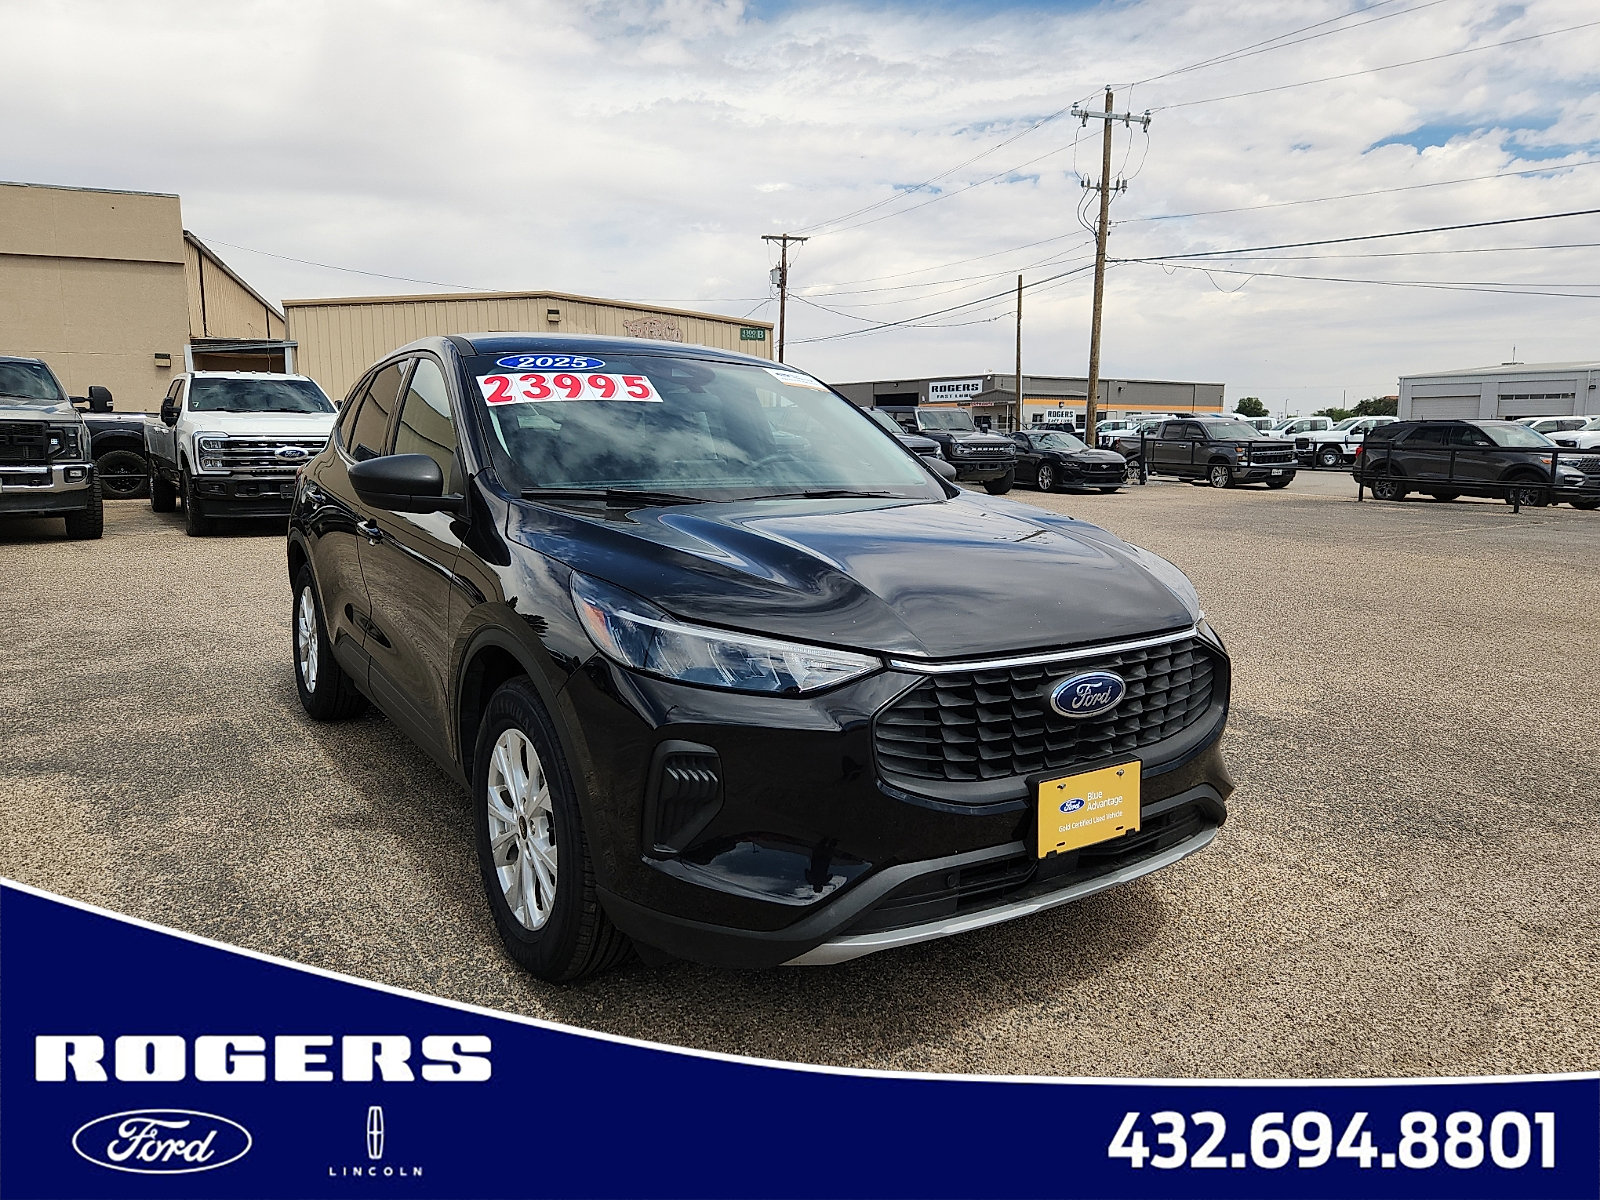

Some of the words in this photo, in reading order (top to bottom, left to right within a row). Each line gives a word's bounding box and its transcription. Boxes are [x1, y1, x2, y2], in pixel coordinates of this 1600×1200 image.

[517, 357, 589, 368] 2025
[484, 374, 654, 403] 23995
[931, 383, 979, 393] ROGERS
[1047, 410, 1074, 418] ROGERS
[1072, 681, 1112, 708] Ford
[1087, 792, 1102, 801] Blue
[1087, 796, 1123, 811] Advantage
[1059, 824, 1071, 832] Gold
[1072, 818, 1092, 828] Certified
[1093, 814, 1105, 823] Used
[1106, 810, 1122, 819] Vehicle
